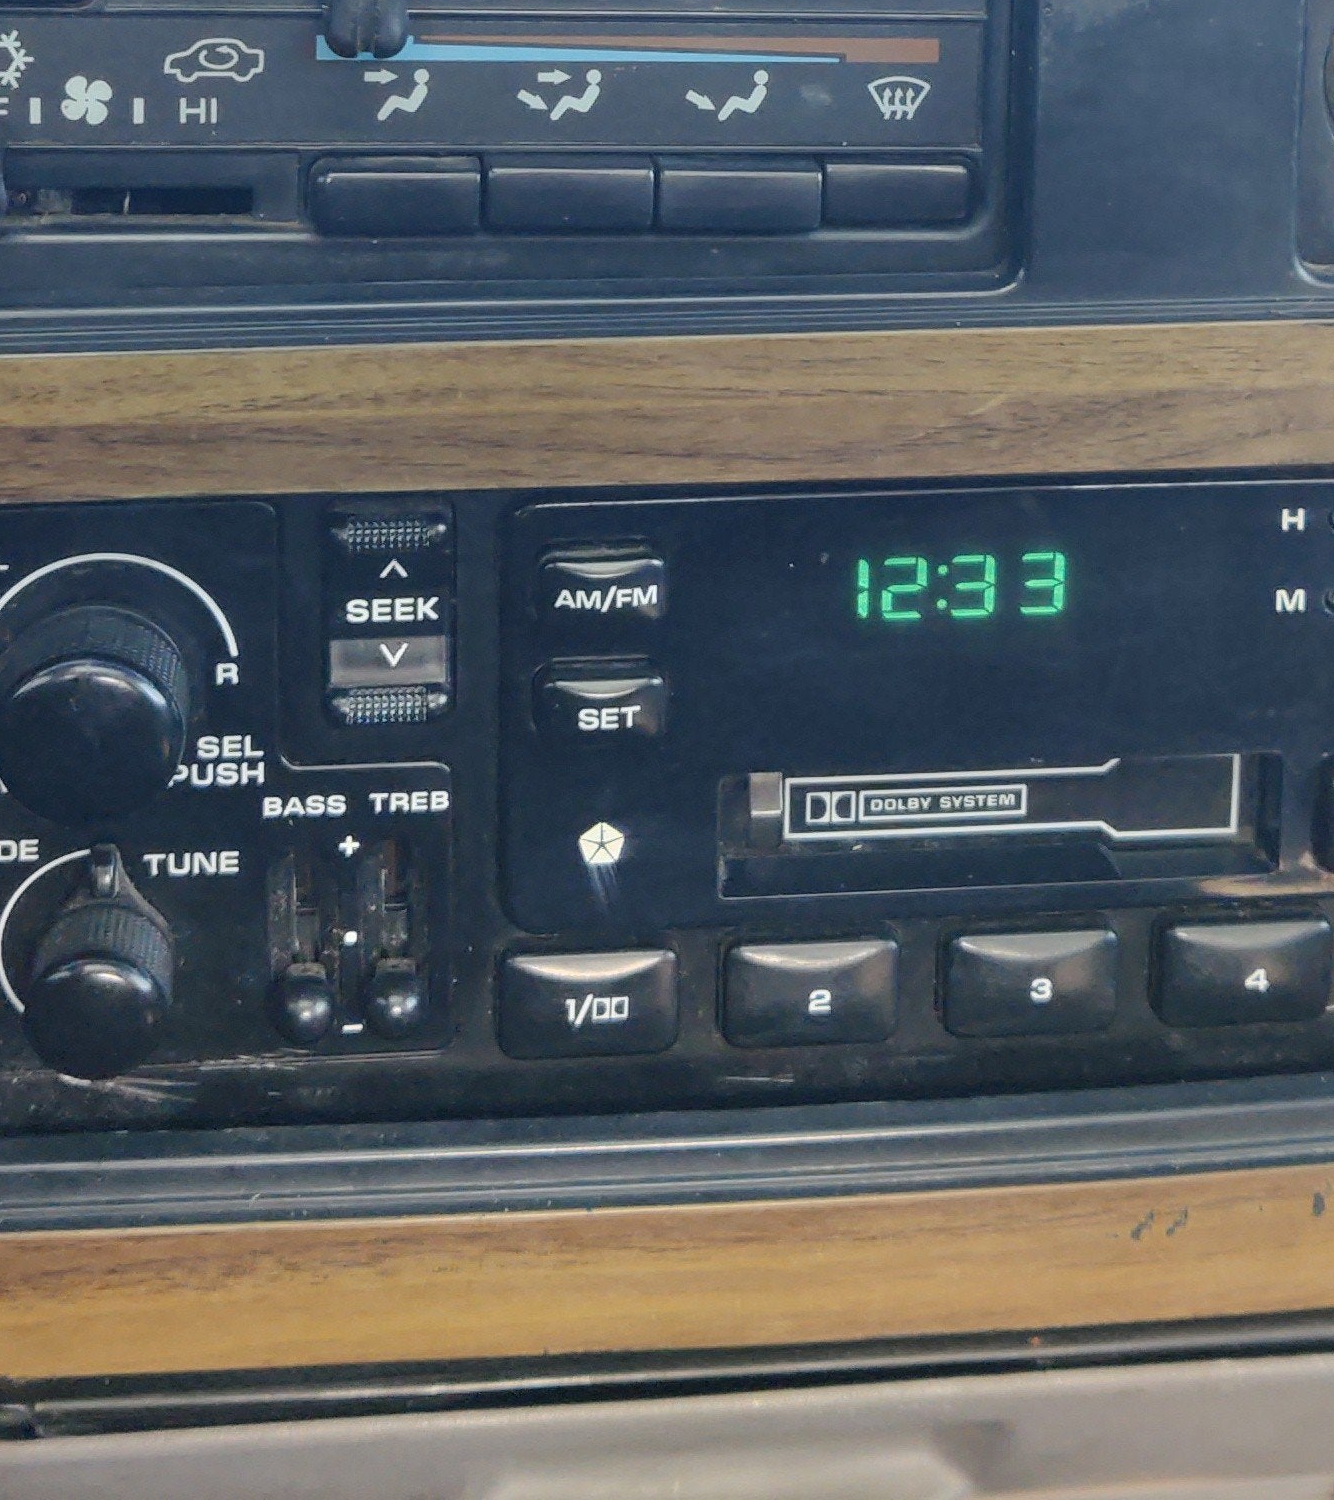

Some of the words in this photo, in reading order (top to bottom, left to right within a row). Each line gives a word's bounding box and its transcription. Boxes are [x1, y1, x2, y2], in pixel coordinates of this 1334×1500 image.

[179, 97, 218, 124] HI
[1280, 508, 1306, 530] H
[554, 585, 658, 610] AM/FM
[856, 551, 1067, 619] 12:33
[345, 598, 440, 623] SEEK
[1275, 589, 1307, 613] M
[215, 662, 240, 686] R
[577, 705, 641, 731] SET
[197, 734, 265, 760] SEL
[167, 761, 266, 789] PUSH
[262, 794, 348, 819] BASS
[368, 791, 450, 814] TREB
[869, 797, 932, 812] DOLBY
[939, 792, 1017, 809] SYSTEM
[142, 851, 241, 877] TUNE
[1029, 977, 1054, 1003] 3
[1243, 967, 1269, 994] 4
[807, 989, 833, 1015] 2
